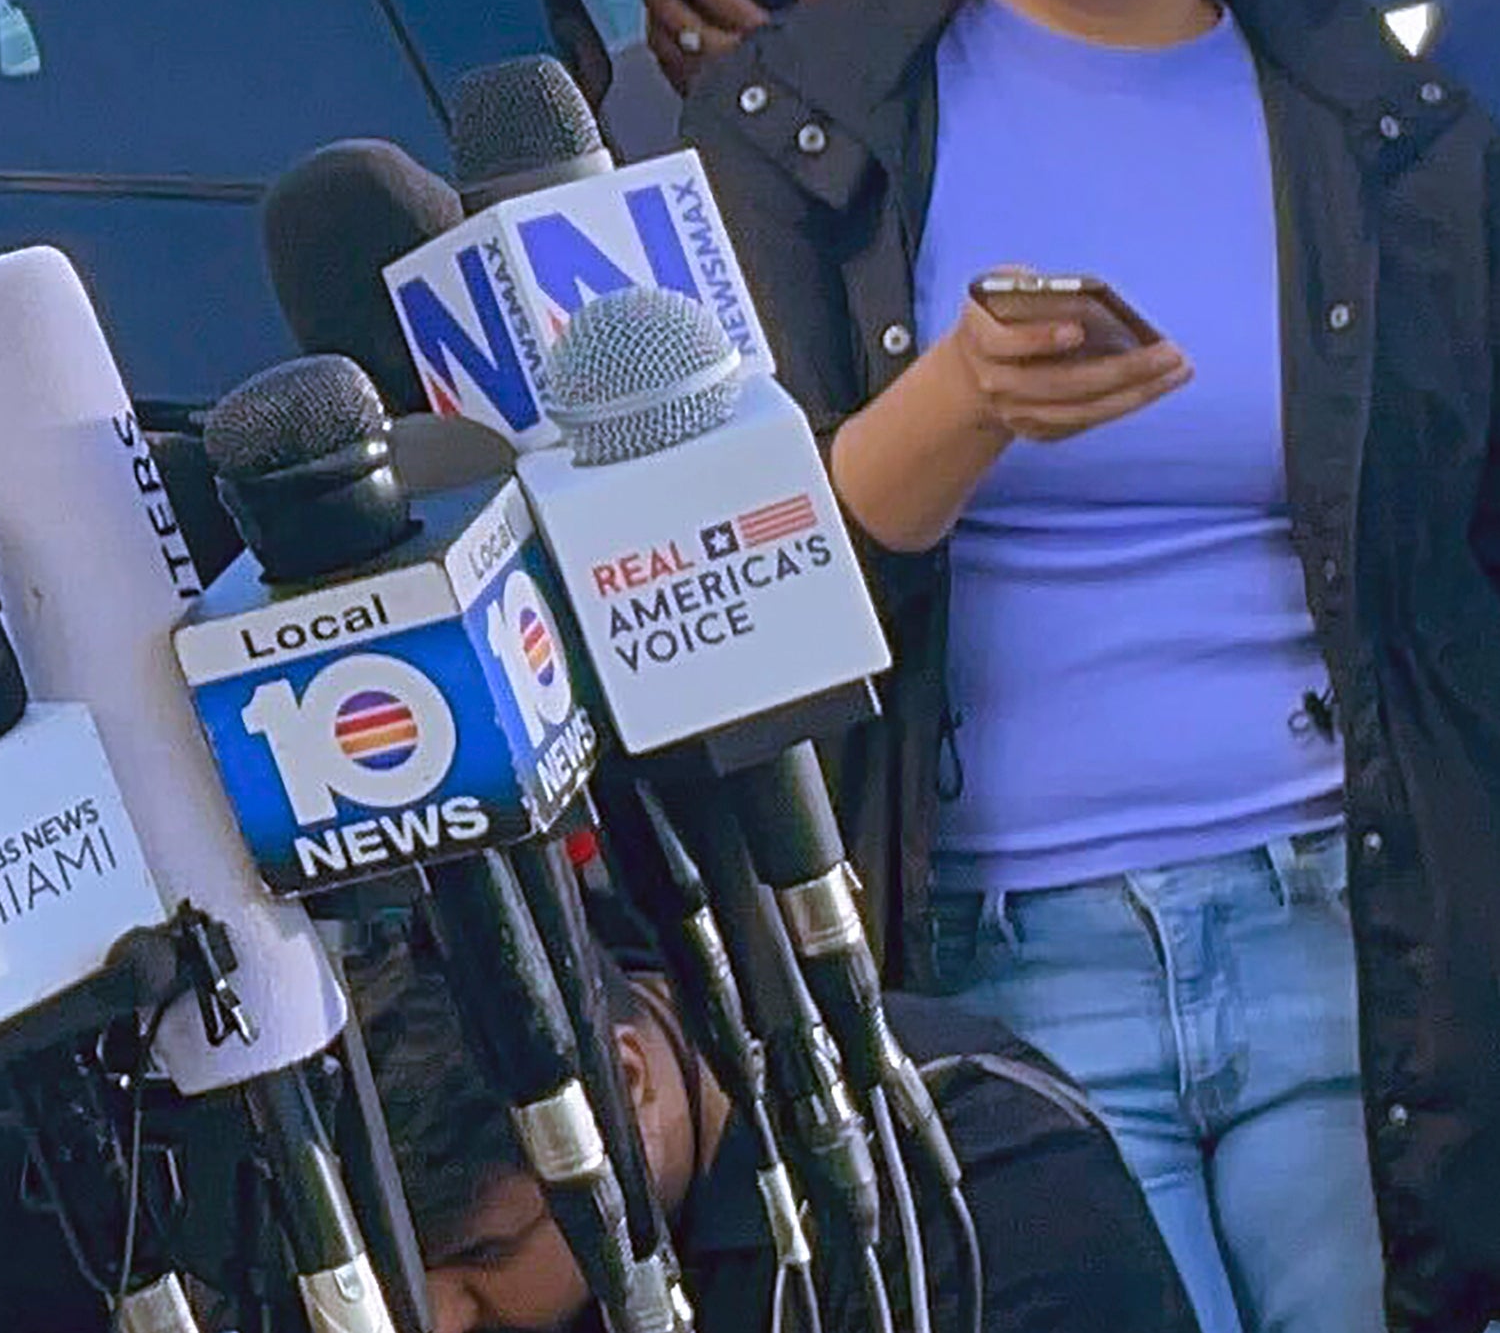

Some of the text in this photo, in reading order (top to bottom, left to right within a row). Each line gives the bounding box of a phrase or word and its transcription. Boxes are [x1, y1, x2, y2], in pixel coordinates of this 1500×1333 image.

[671, 177, 757, 359] NEWSMAX
[591, 539, 696, 598] REAL
[608, 534, 833, 639] AMERICA'S
[240, 593, 389, 660] Local
[614, 601, 755, 674] VOICE
[240, 652, 457, 826] 10
[21, 798, 101, 856] NEWS
[294, 795, 491, 878] NEWS
